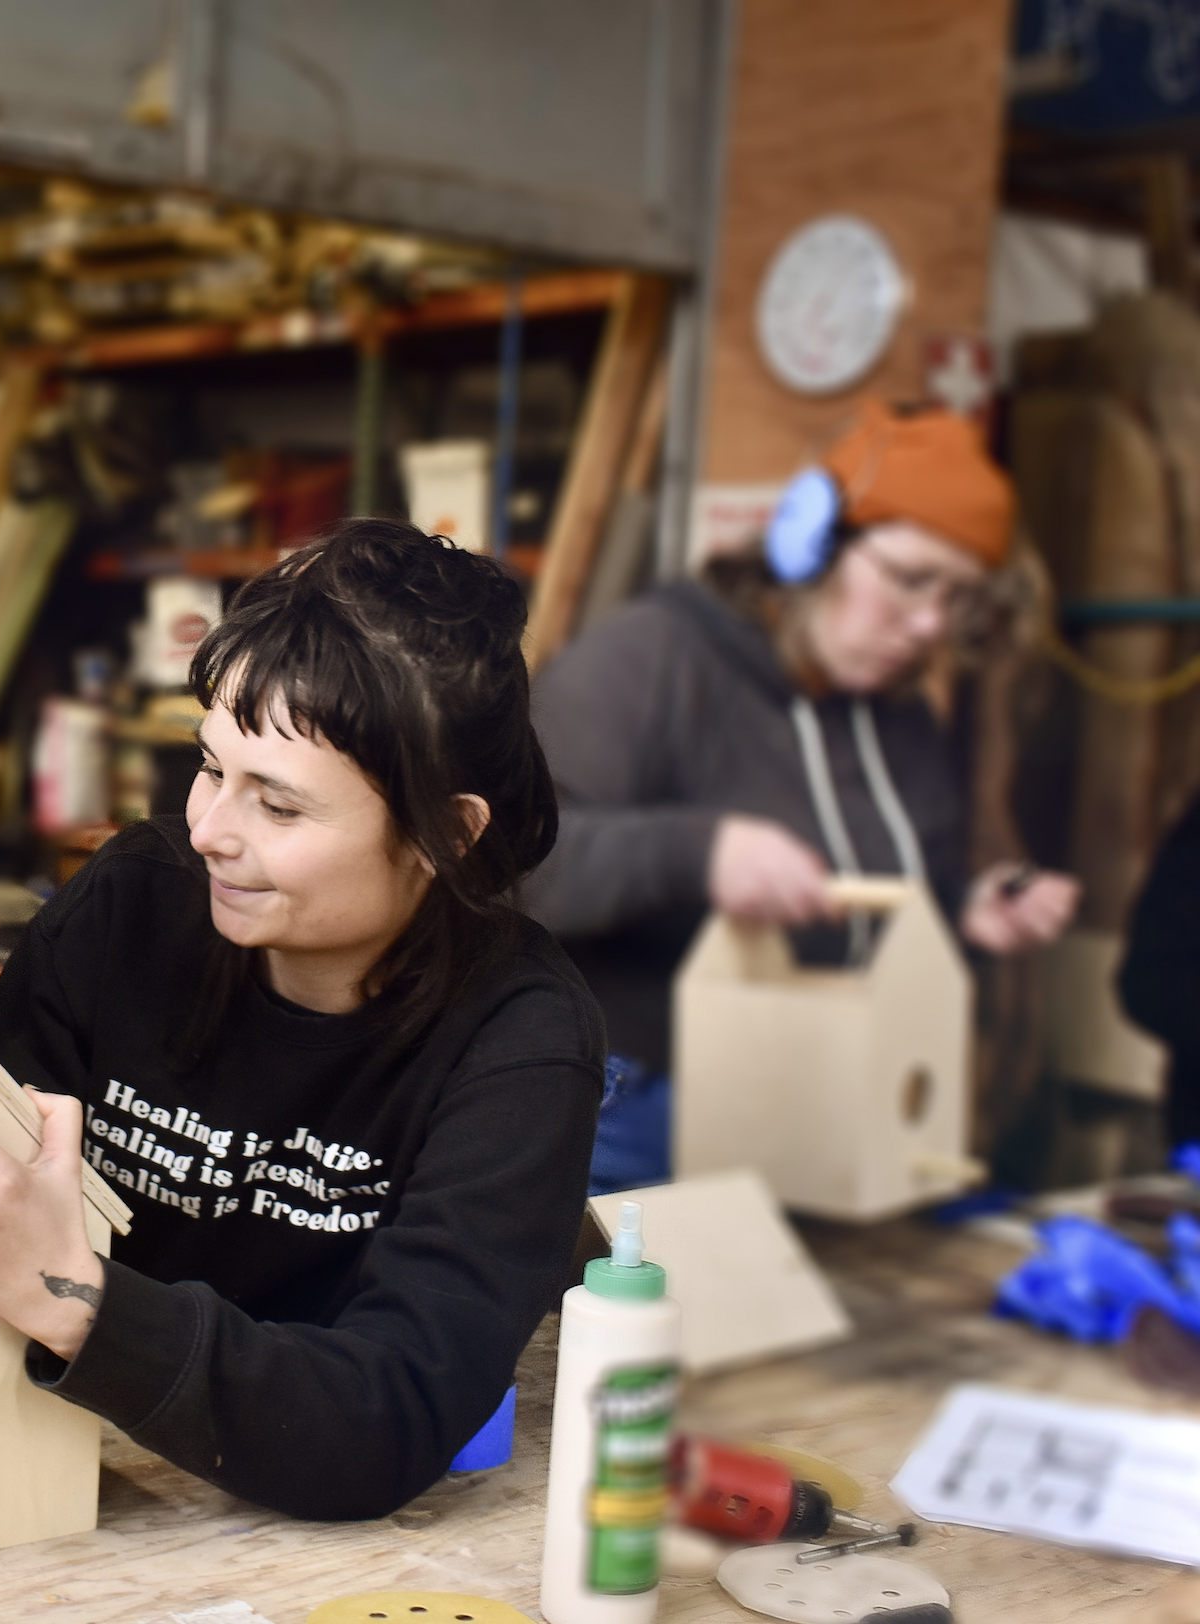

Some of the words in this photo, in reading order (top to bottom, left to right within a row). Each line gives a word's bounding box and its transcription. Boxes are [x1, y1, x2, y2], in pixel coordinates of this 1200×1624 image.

[103, 1078, 234, 1159] Healing
[242, 1132, 274, 1159] is
[84, 1137, 202, 1220] Healing
[212, 1195, 240, 1219] is
[199, 1156, 234, 1188] is
